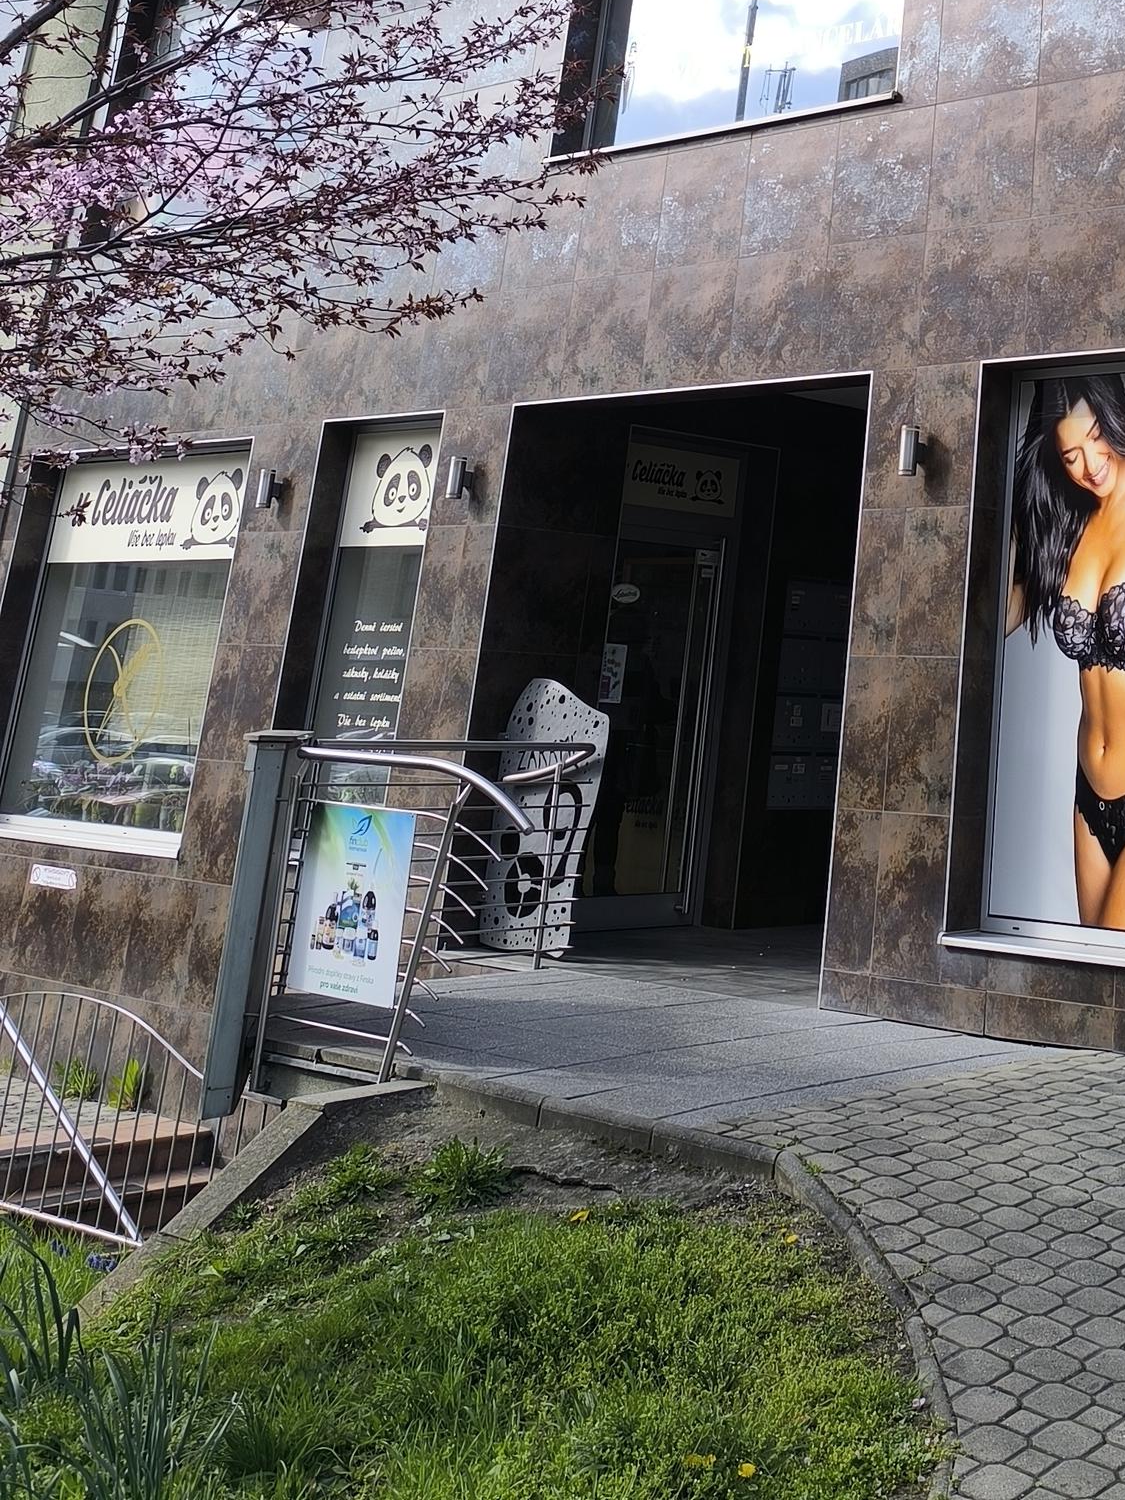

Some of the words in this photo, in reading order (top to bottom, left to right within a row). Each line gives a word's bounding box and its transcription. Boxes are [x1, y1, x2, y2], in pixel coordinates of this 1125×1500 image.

[128, 531, 140, 548] Vše
[141, 530, 154, 546] bez
[155, 528, 177, 551] lepku
[355, 714, 366, 726] bez
